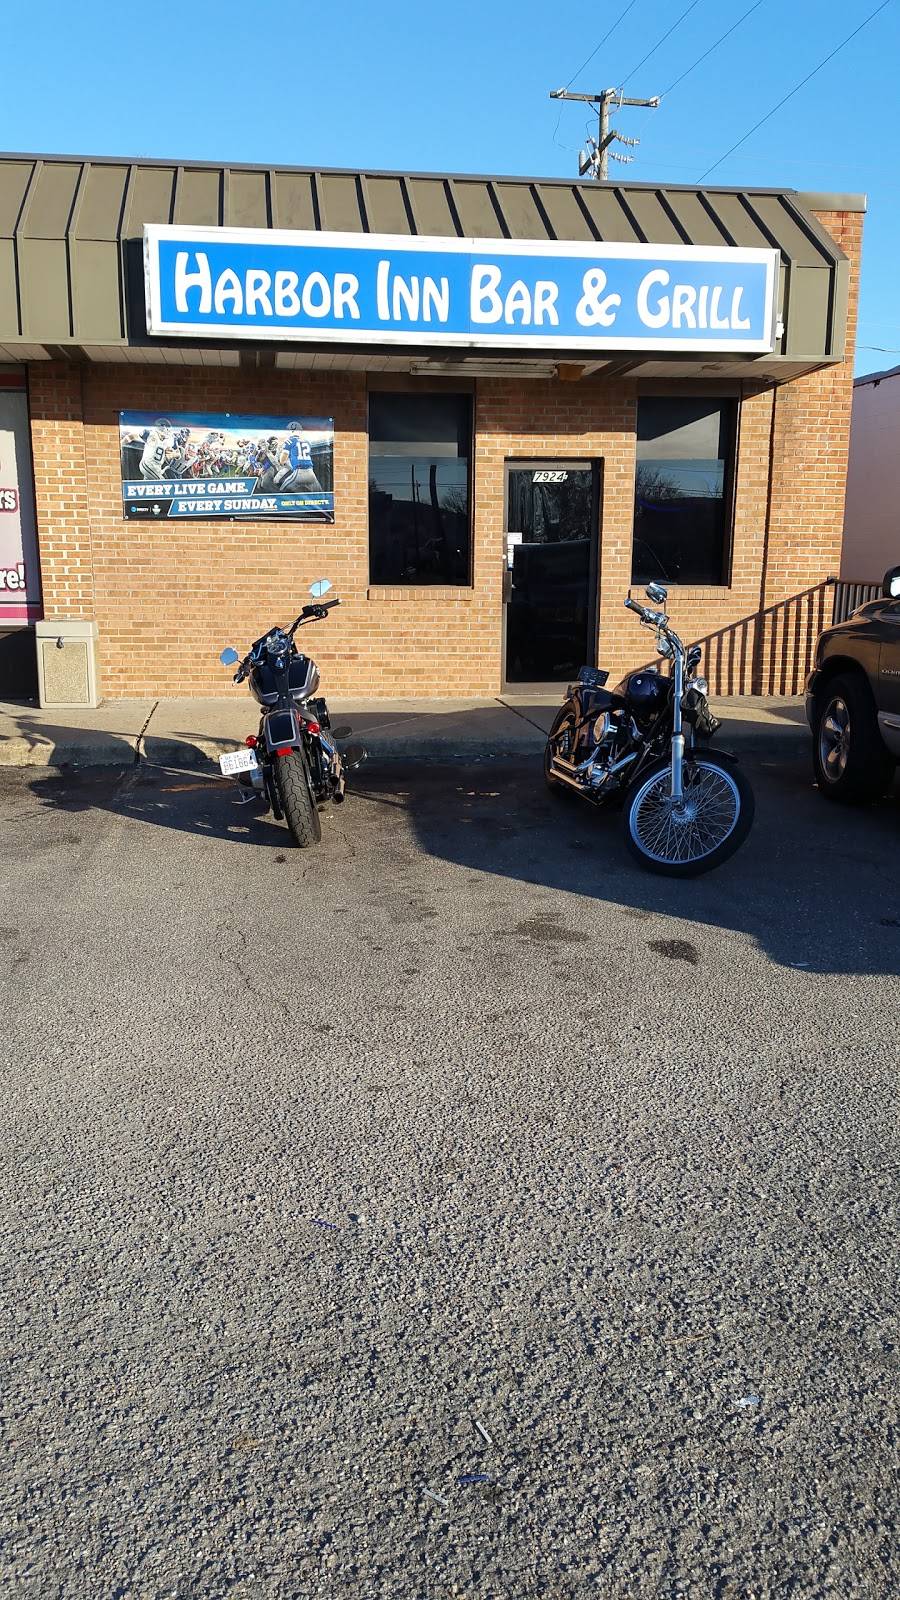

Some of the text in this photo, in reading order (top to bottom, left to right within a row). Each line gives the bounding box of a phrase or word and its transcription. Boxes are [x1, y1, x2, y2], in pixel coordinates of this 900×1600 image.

[174, 251, 751, 330] HARBOR INN BAR & GRILL
[296, 440, 312, 461] 12
[534, 472, 564, 481] 7924
[127, 481, 249, 497] EVERY LIVE GAME.
[177, 499, 223, 512] EVERY
[223, 498, 278, 510] SUNDAY.
